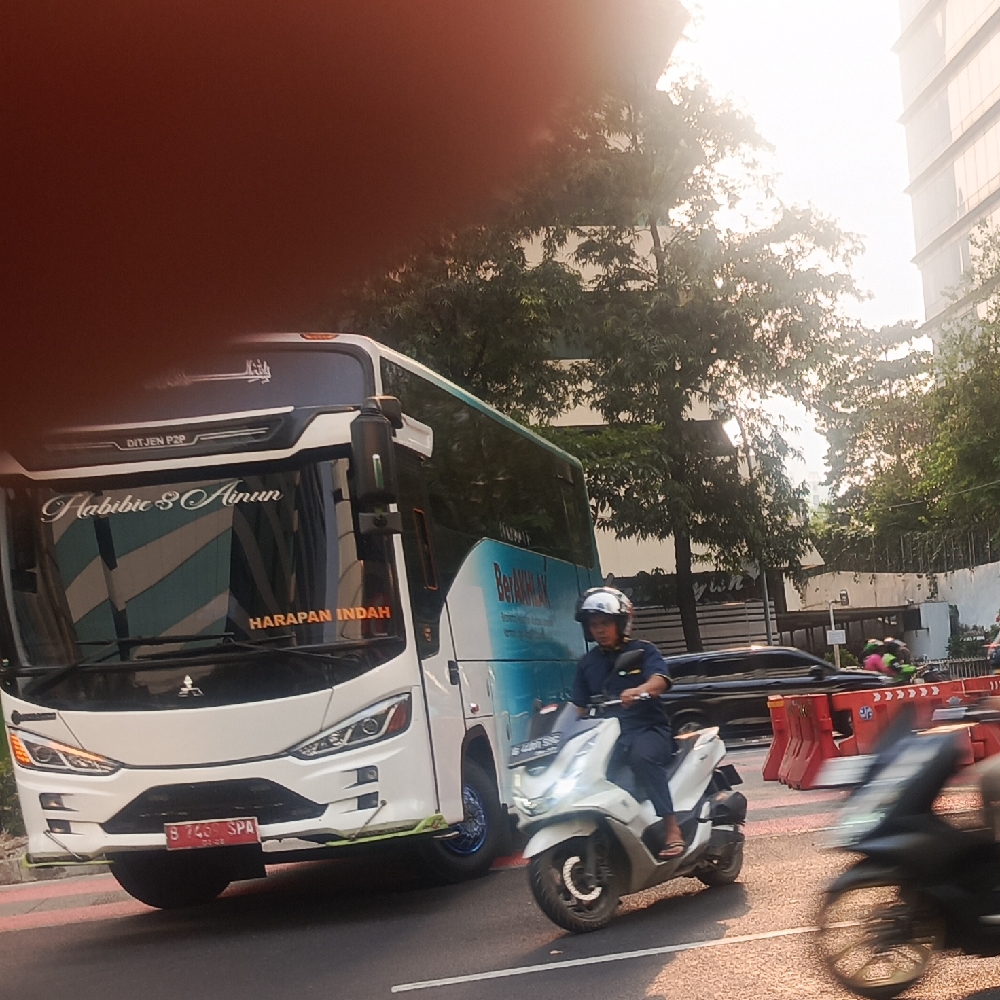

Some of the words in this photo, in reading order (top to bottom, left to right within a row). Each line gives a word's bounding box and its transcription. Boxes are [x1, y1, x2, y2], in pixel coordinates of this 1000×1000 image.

[126, 436, 165, 448] DITJEN
[165, 434, 186, 445] P2P
[181, 479, 284, 511] Ainun
[249, 609, 332, 630] HARAPAN
[336, 606, 391, 621] INDAH
[170, 826, 179, 841] B
[228, 820, 254, 835] SPA
